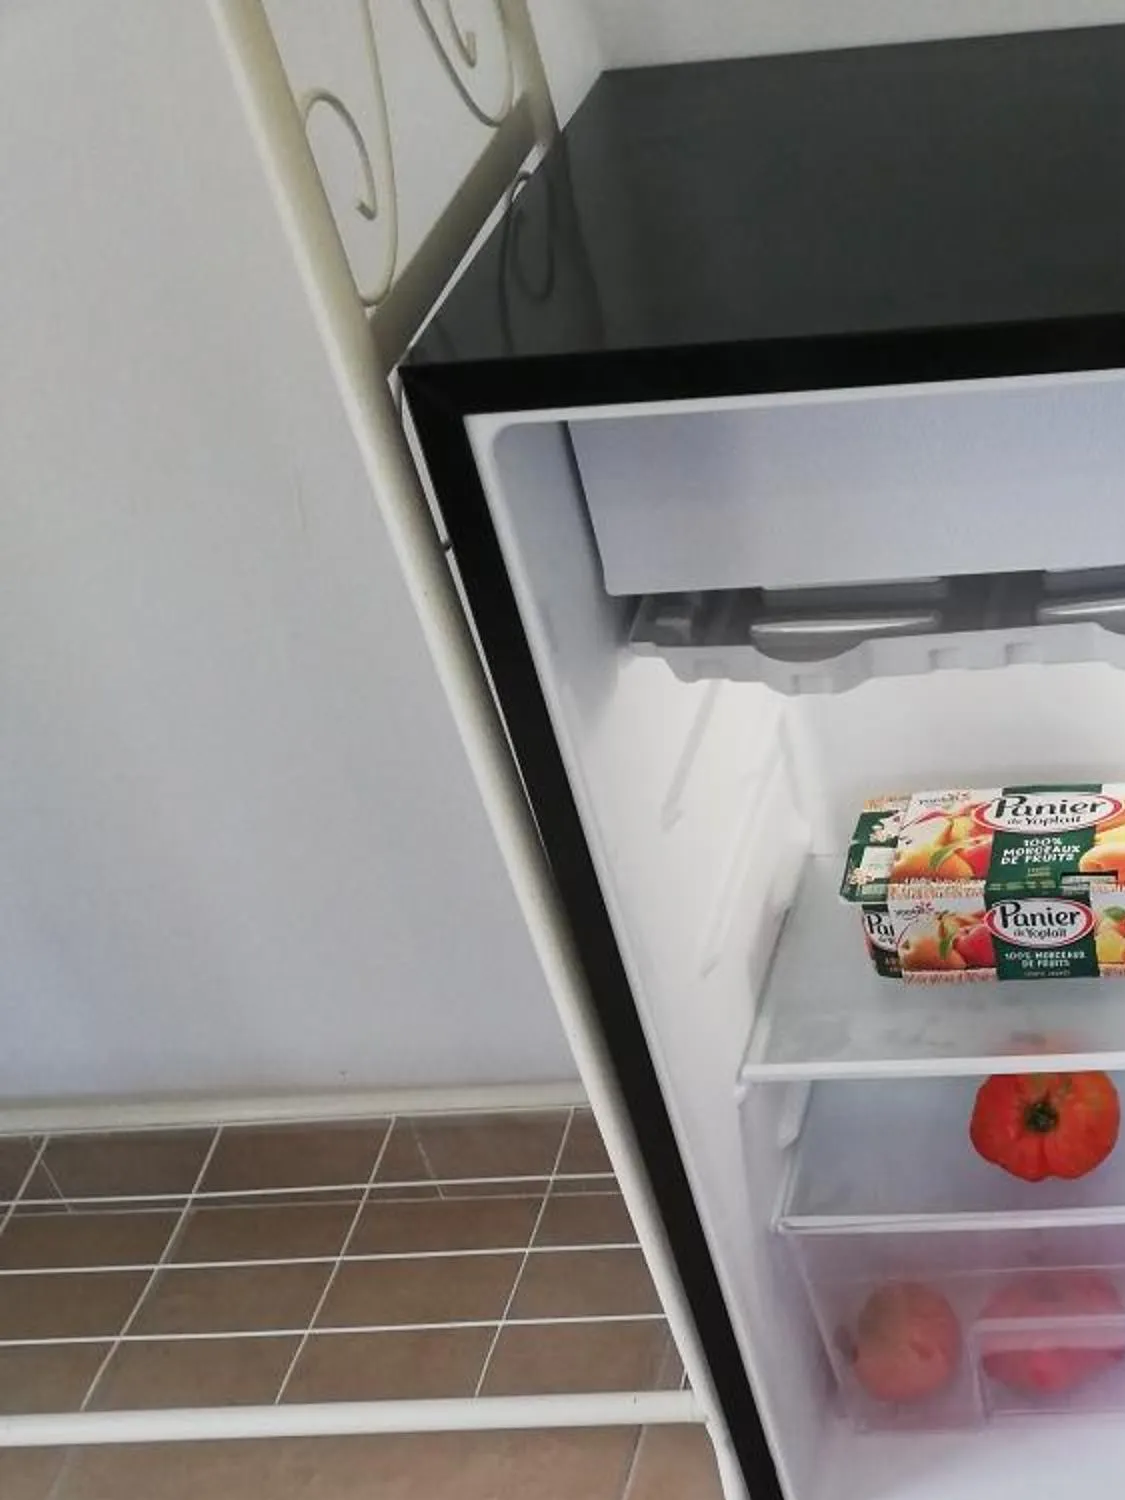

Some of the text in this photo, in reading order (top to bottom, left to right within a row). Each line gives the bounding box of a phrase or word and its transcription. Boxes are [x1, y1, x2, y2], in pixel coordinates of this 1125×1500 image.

[992, 796, 1107, 818] Panier
[1025, 815, 1081, 827] Yoplait
[1024, 837, 1063, 847] 100%
[1003, 845, 1081, 857] MORCEAUX
[1001, 853, 1075, 865] DE FRUITS
[992, 900, 1081, 929] Panier
[1026, 927, 1067, 940] Yoplait
